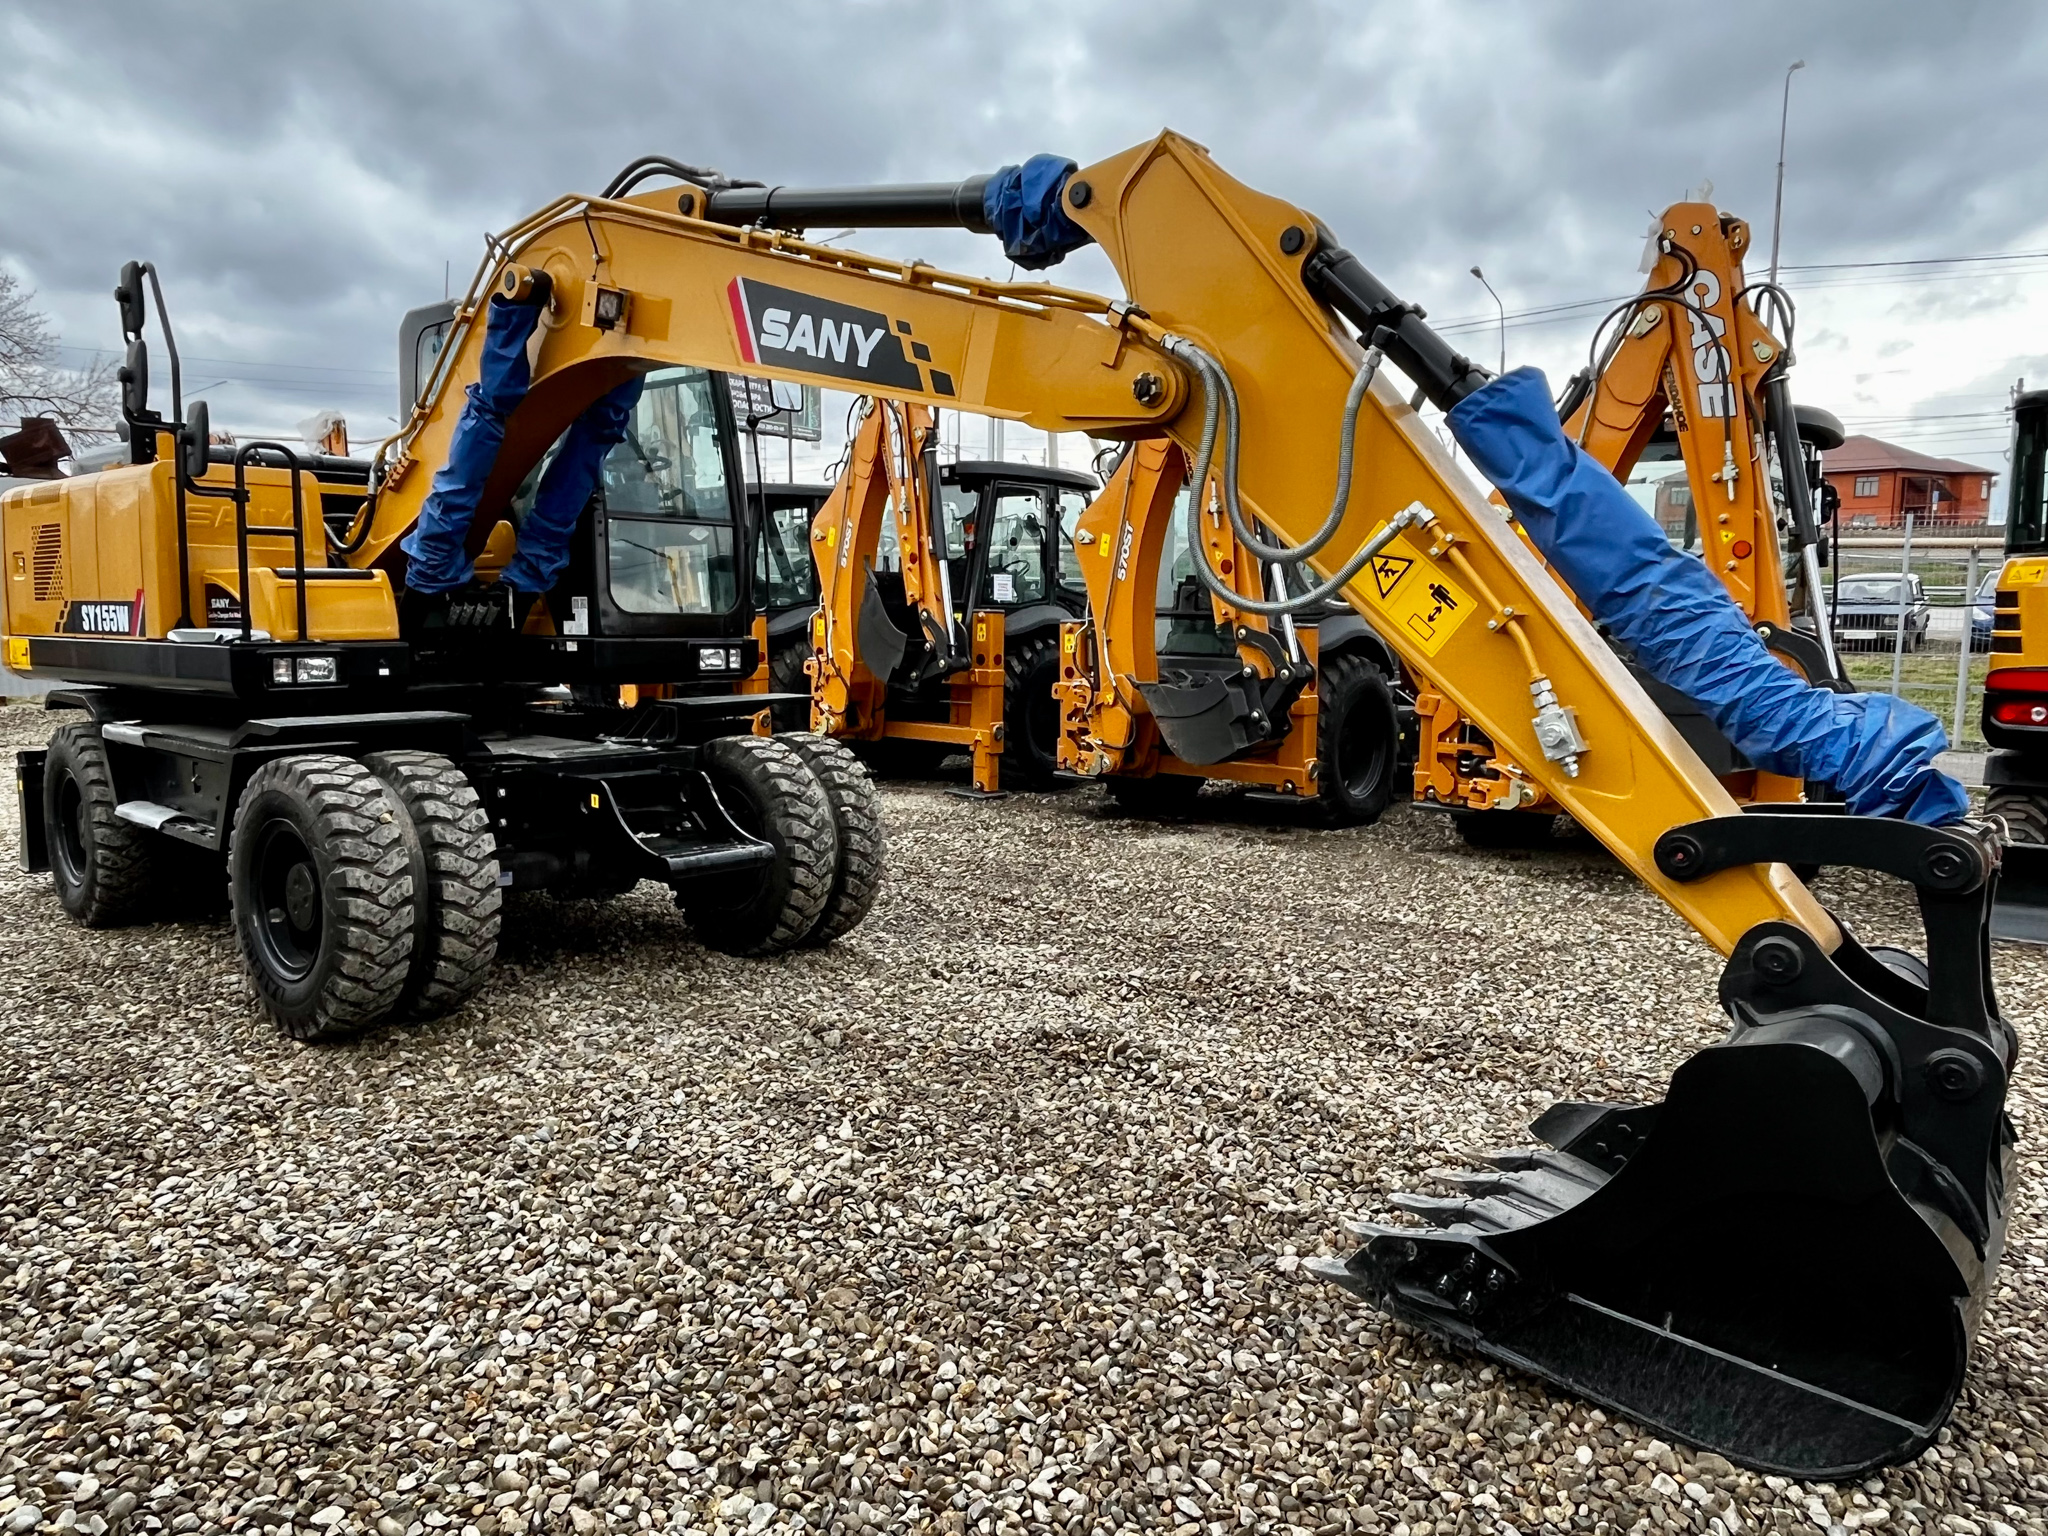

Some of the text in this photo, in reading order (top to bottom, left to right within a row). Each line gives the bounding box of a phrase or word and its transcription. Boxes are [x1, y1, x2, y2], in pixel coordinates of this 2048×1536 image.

[760, 307, 886, 368] SANY
[1684, 269, 1737, 418] CASE
[1117, 520, 1134, 582] 570ST
[81, 604, 129, 633] SY155W
